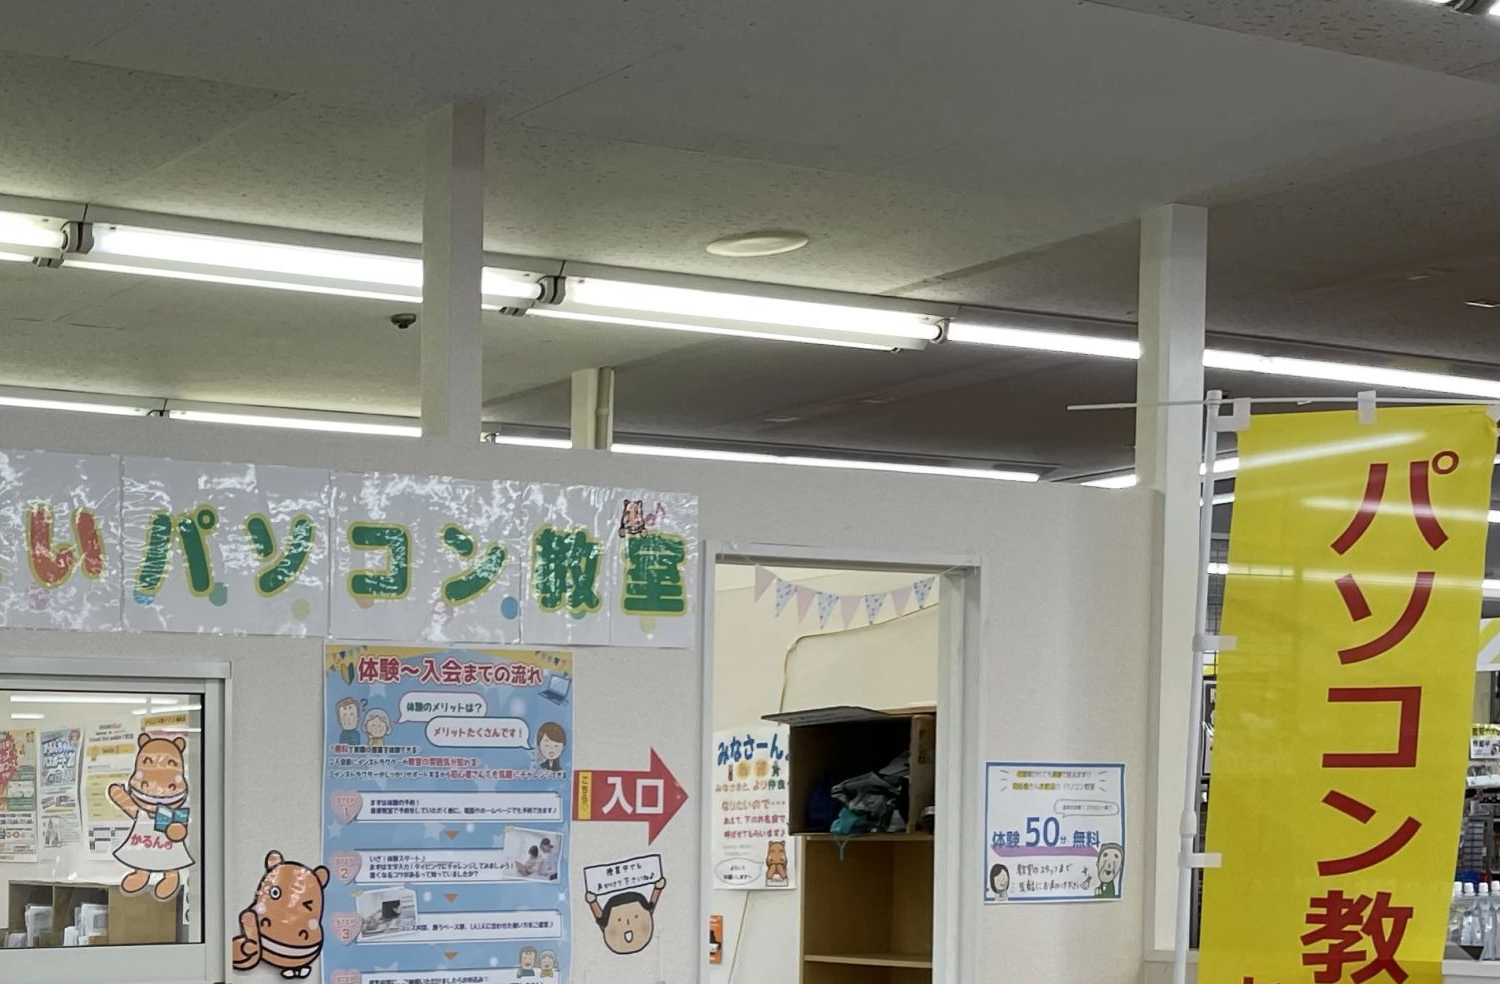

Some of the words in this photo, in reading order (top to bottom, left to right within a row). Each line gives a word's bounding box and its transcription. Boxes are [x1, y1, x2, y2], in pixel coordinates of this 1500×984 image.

[601, 776, 664, 815] 入口
[992, 831, 1020, 849] 体験
[1073, 830, 1100, 848] 無料
[341, 867, 349, 878] 2
[342, 928, 350, 939] 3
